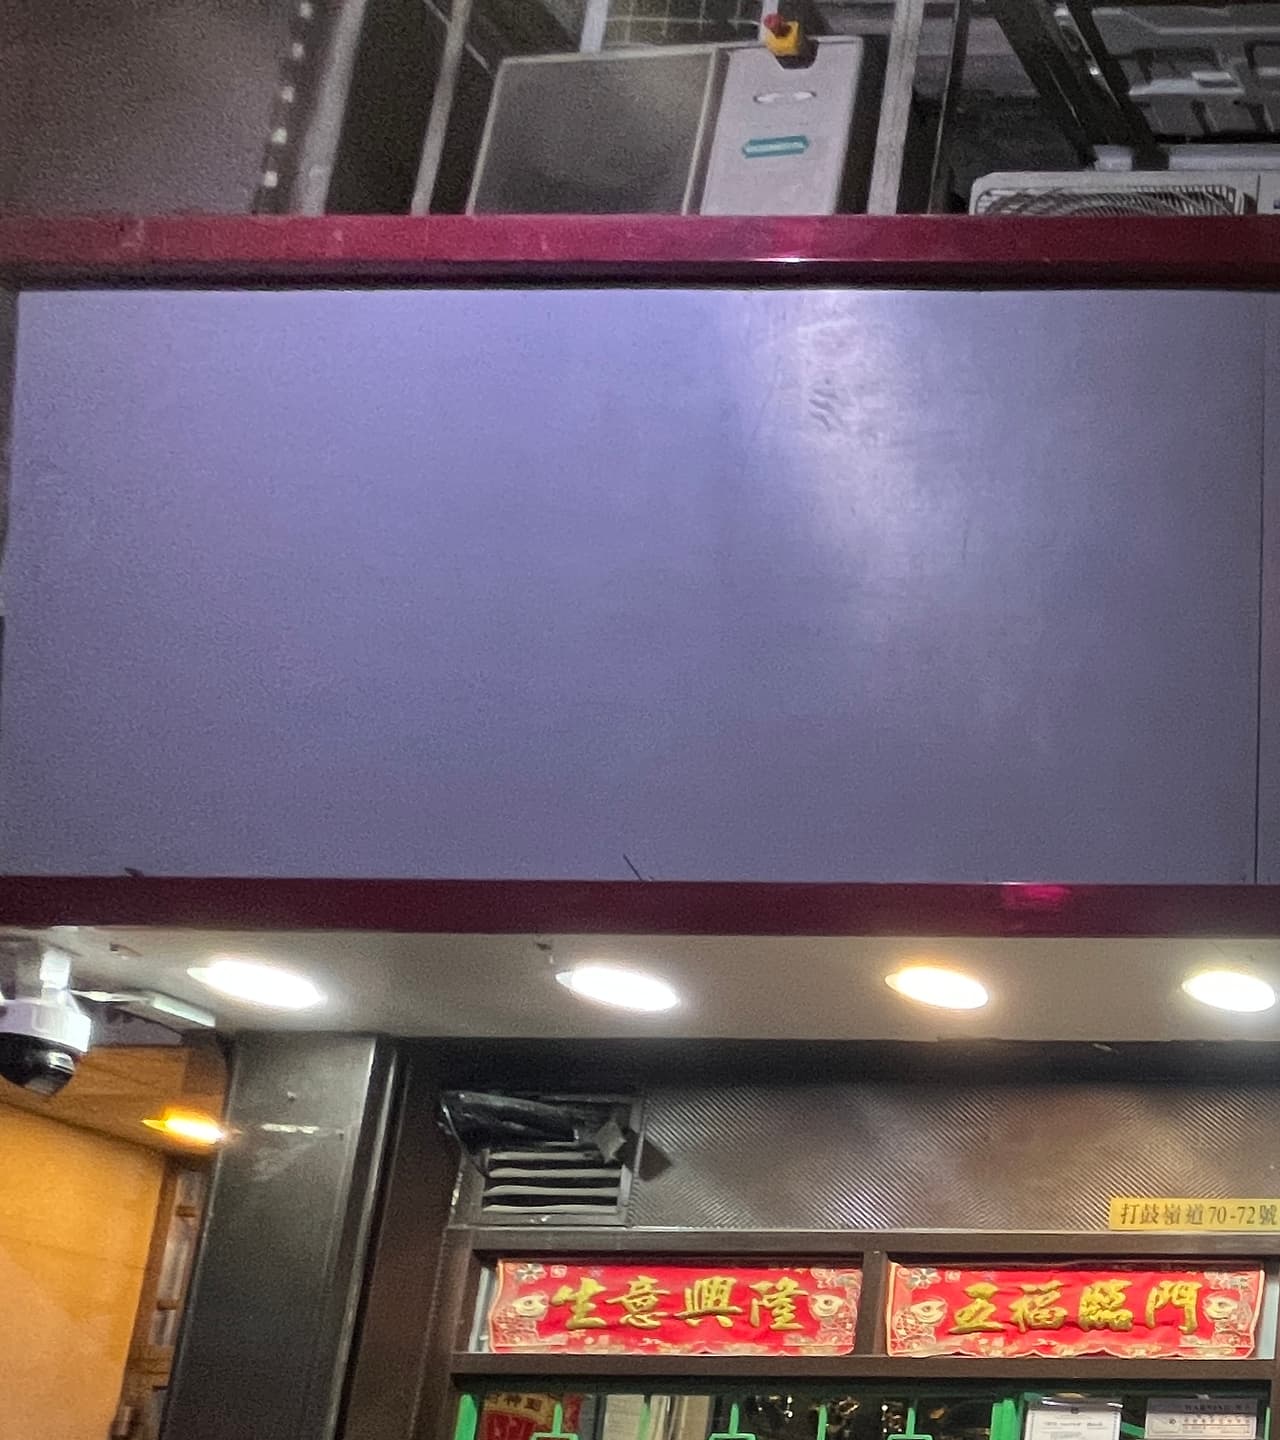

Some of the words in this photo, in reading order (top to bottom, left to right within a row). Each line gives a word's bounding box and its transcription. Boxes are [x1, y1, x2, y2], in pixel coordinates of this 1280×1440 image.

[550, 1276, 809, 1331] 生意興隆
[947, 1280, 1204, 1335] 五福臨門
